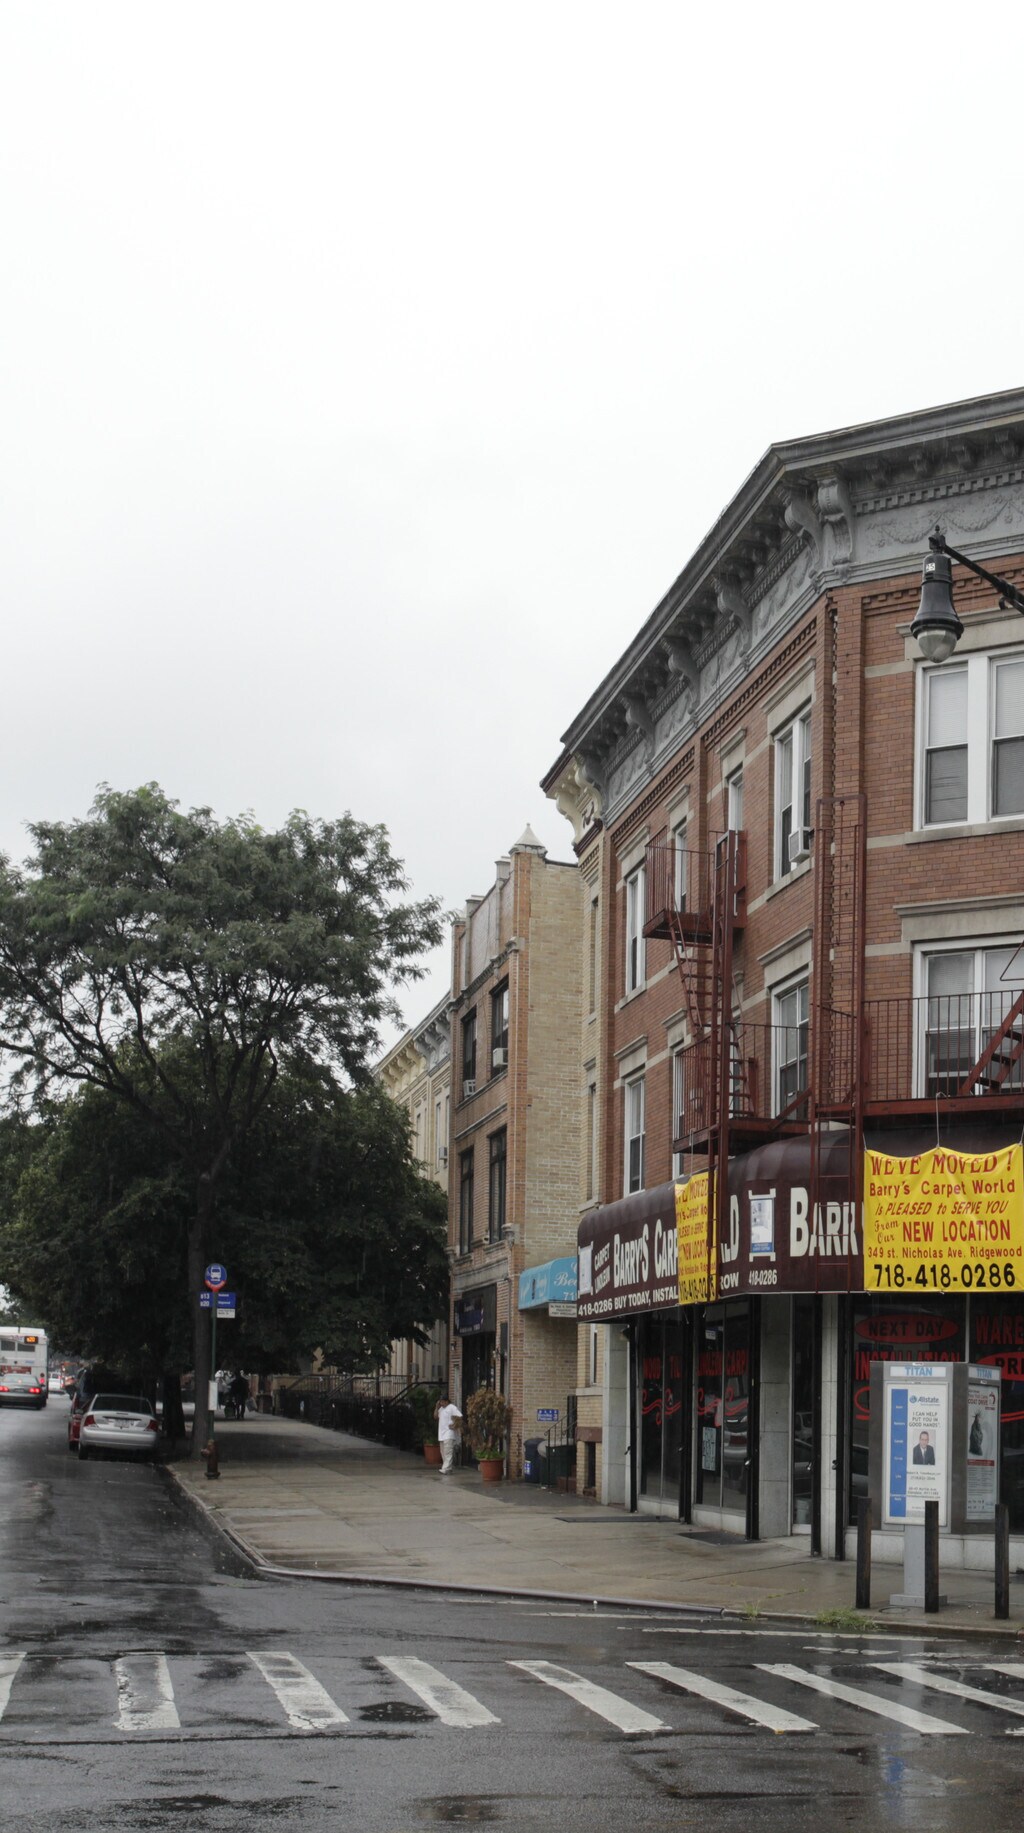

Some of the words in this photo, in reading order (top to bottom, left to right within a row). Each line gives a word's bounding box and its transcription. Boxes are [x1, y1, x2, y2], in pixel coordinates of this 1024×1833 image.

[871, 1155, 921, 1175] WEVE
[869, 1181, 911, 1198] Barry's
[921, 1180, 967, 1197] Carpet
[972, 1179, 1016, 1195] World
[885, 1202, 933, 1216] PLEASED
[936, 1202, 947, 1215] to
[951, 1201, 983, 1215] SERVE
[985, 1200, 1009, 1214] YOU
[790, 1187, 864, 1257] BARR
[874, 1219, 900, 1233] From
[877, 1232, 896, 1245] Our
[902, 1221, 934, 1242] NEW
[942, 1219, 1011, 1242] LOCATION
[613, 1223, 649, 1289] BARRY'S
[654, 1218, 678, 1279] CARP
[867, 1248, 884, 1258] 349
[902, 1247, 944, 1259] Nicholas
[970, 1246, 1023, 1260] Ridgewood
[748, 1269, 778, 1286] 418-0286
[874, 1263, 1016, 1288] 718-418-0286
[578, 1301, 613, 1316] 418-0286
[614, 1298, 628, 1311] BUY
[653, 1286, 678, 1303] INSTAL
[868, 1322, 908, 1337] NEXT
[915, 1321, 944, 1337] DAY
[905, 1365, 933, 1376] TITAN
[976, 1367, 992, 1379] TITAN
[918, 1396, 939, 1404] Allstate
